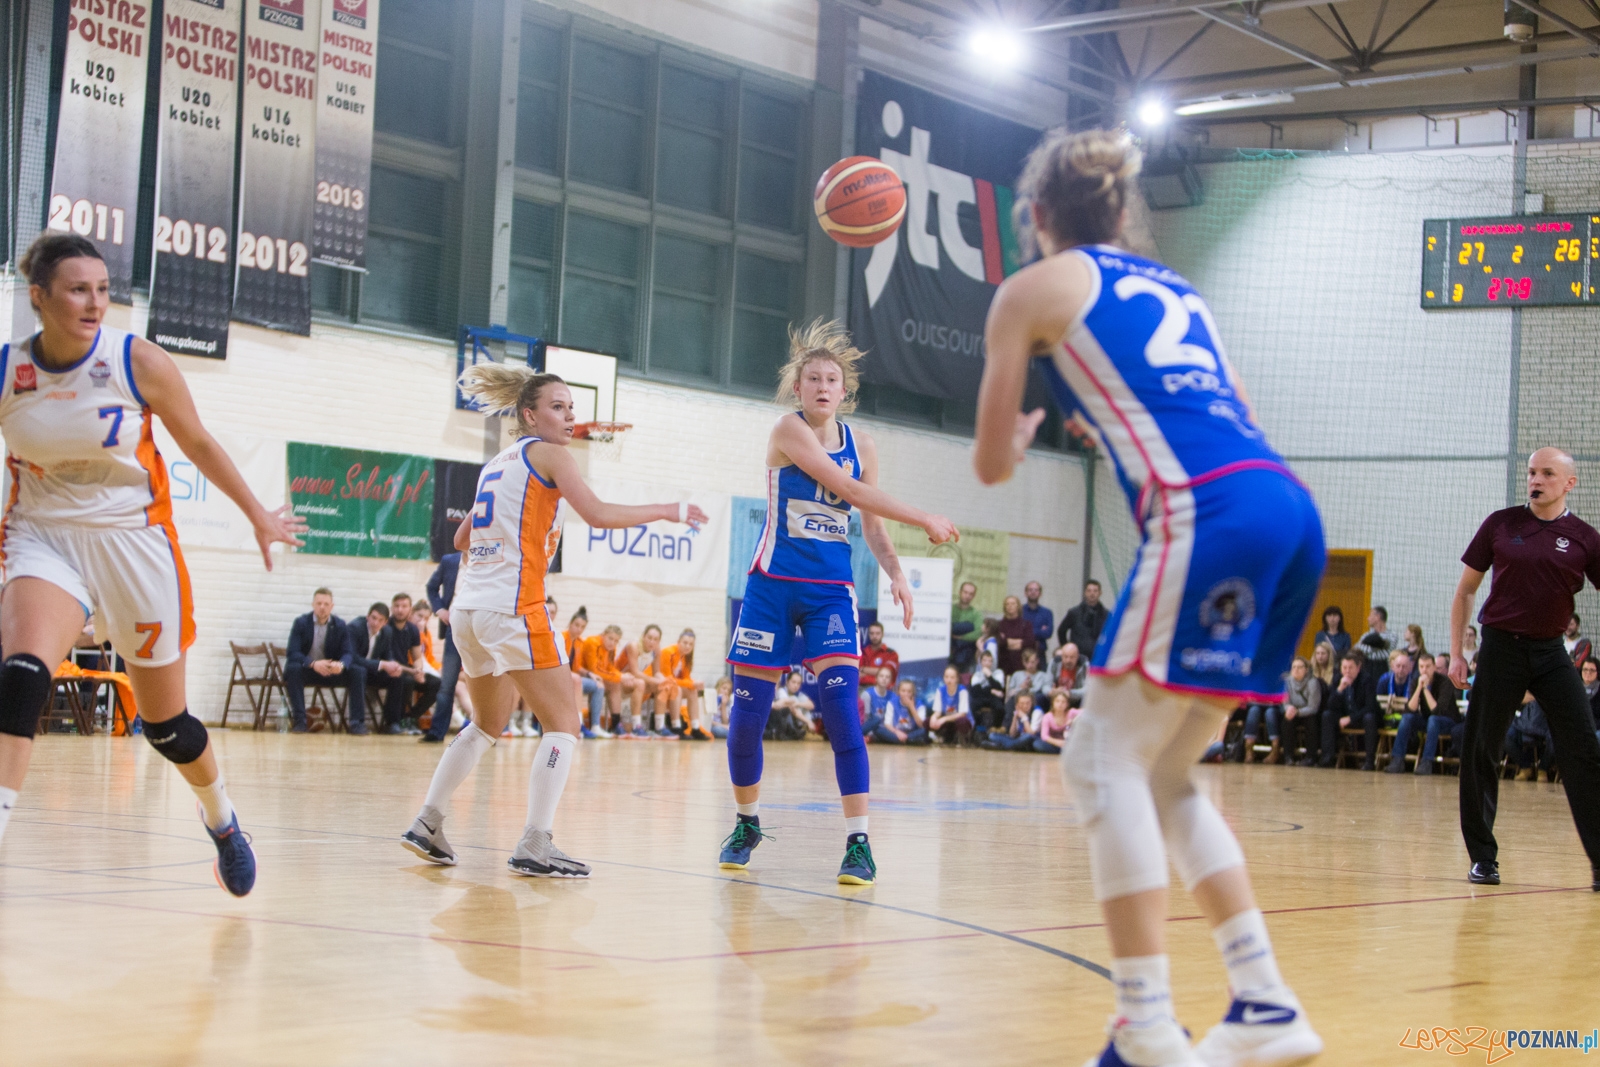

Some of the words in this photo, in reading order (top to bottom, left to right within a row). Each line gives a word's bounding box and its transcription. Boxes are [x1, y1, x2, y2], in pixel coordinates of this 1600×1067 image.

[68, 14, 142, 57] POLSKI
[166, 13, 238, 54] MISTRZ
[323, 29, 373, 57] MISTRZ
[165, 42, 235, 81] POLSKI
[247, 35, 316, 73] MISTRZ
[322, 51, 372, 79] POLSKI
[85, 60, 115, 83] U20
[247, 63, 313, 100] POLSKI
[70, 78, 125, 108] kobiet
[182, 86, 211, 108] U20
[336, 81, 357, 96] U16
[169, 104, 221, 130] kobiet
[263, 105, 291, 126] U16
[326, 94, 366, 115] KOBIET
[252, 120, 301, 148] kobiet
[316, 181, 365, 210] 2013
[843, 172, 891, 196] molten
[49, 194, 125, 245] 2011
[156, 216, 227, 262] 2012
[1458, 242, 1485, 265] 27
[1512, 245, 1524, 264] 2
[1554, 239, 1581, 262] 26
[237, 232, 308, 277] 2012
[155, 333, 217, 353] www.pzkosz.pl
[98, 405, 124, 448] 7
[472, 469, 504, 530] 5
[804, 518, 845, 535] Enea
[135, 621, 162, 658] 7
[749, 641, 771, 650] Motors
[823, 638, 852, 646] AVENIDA
